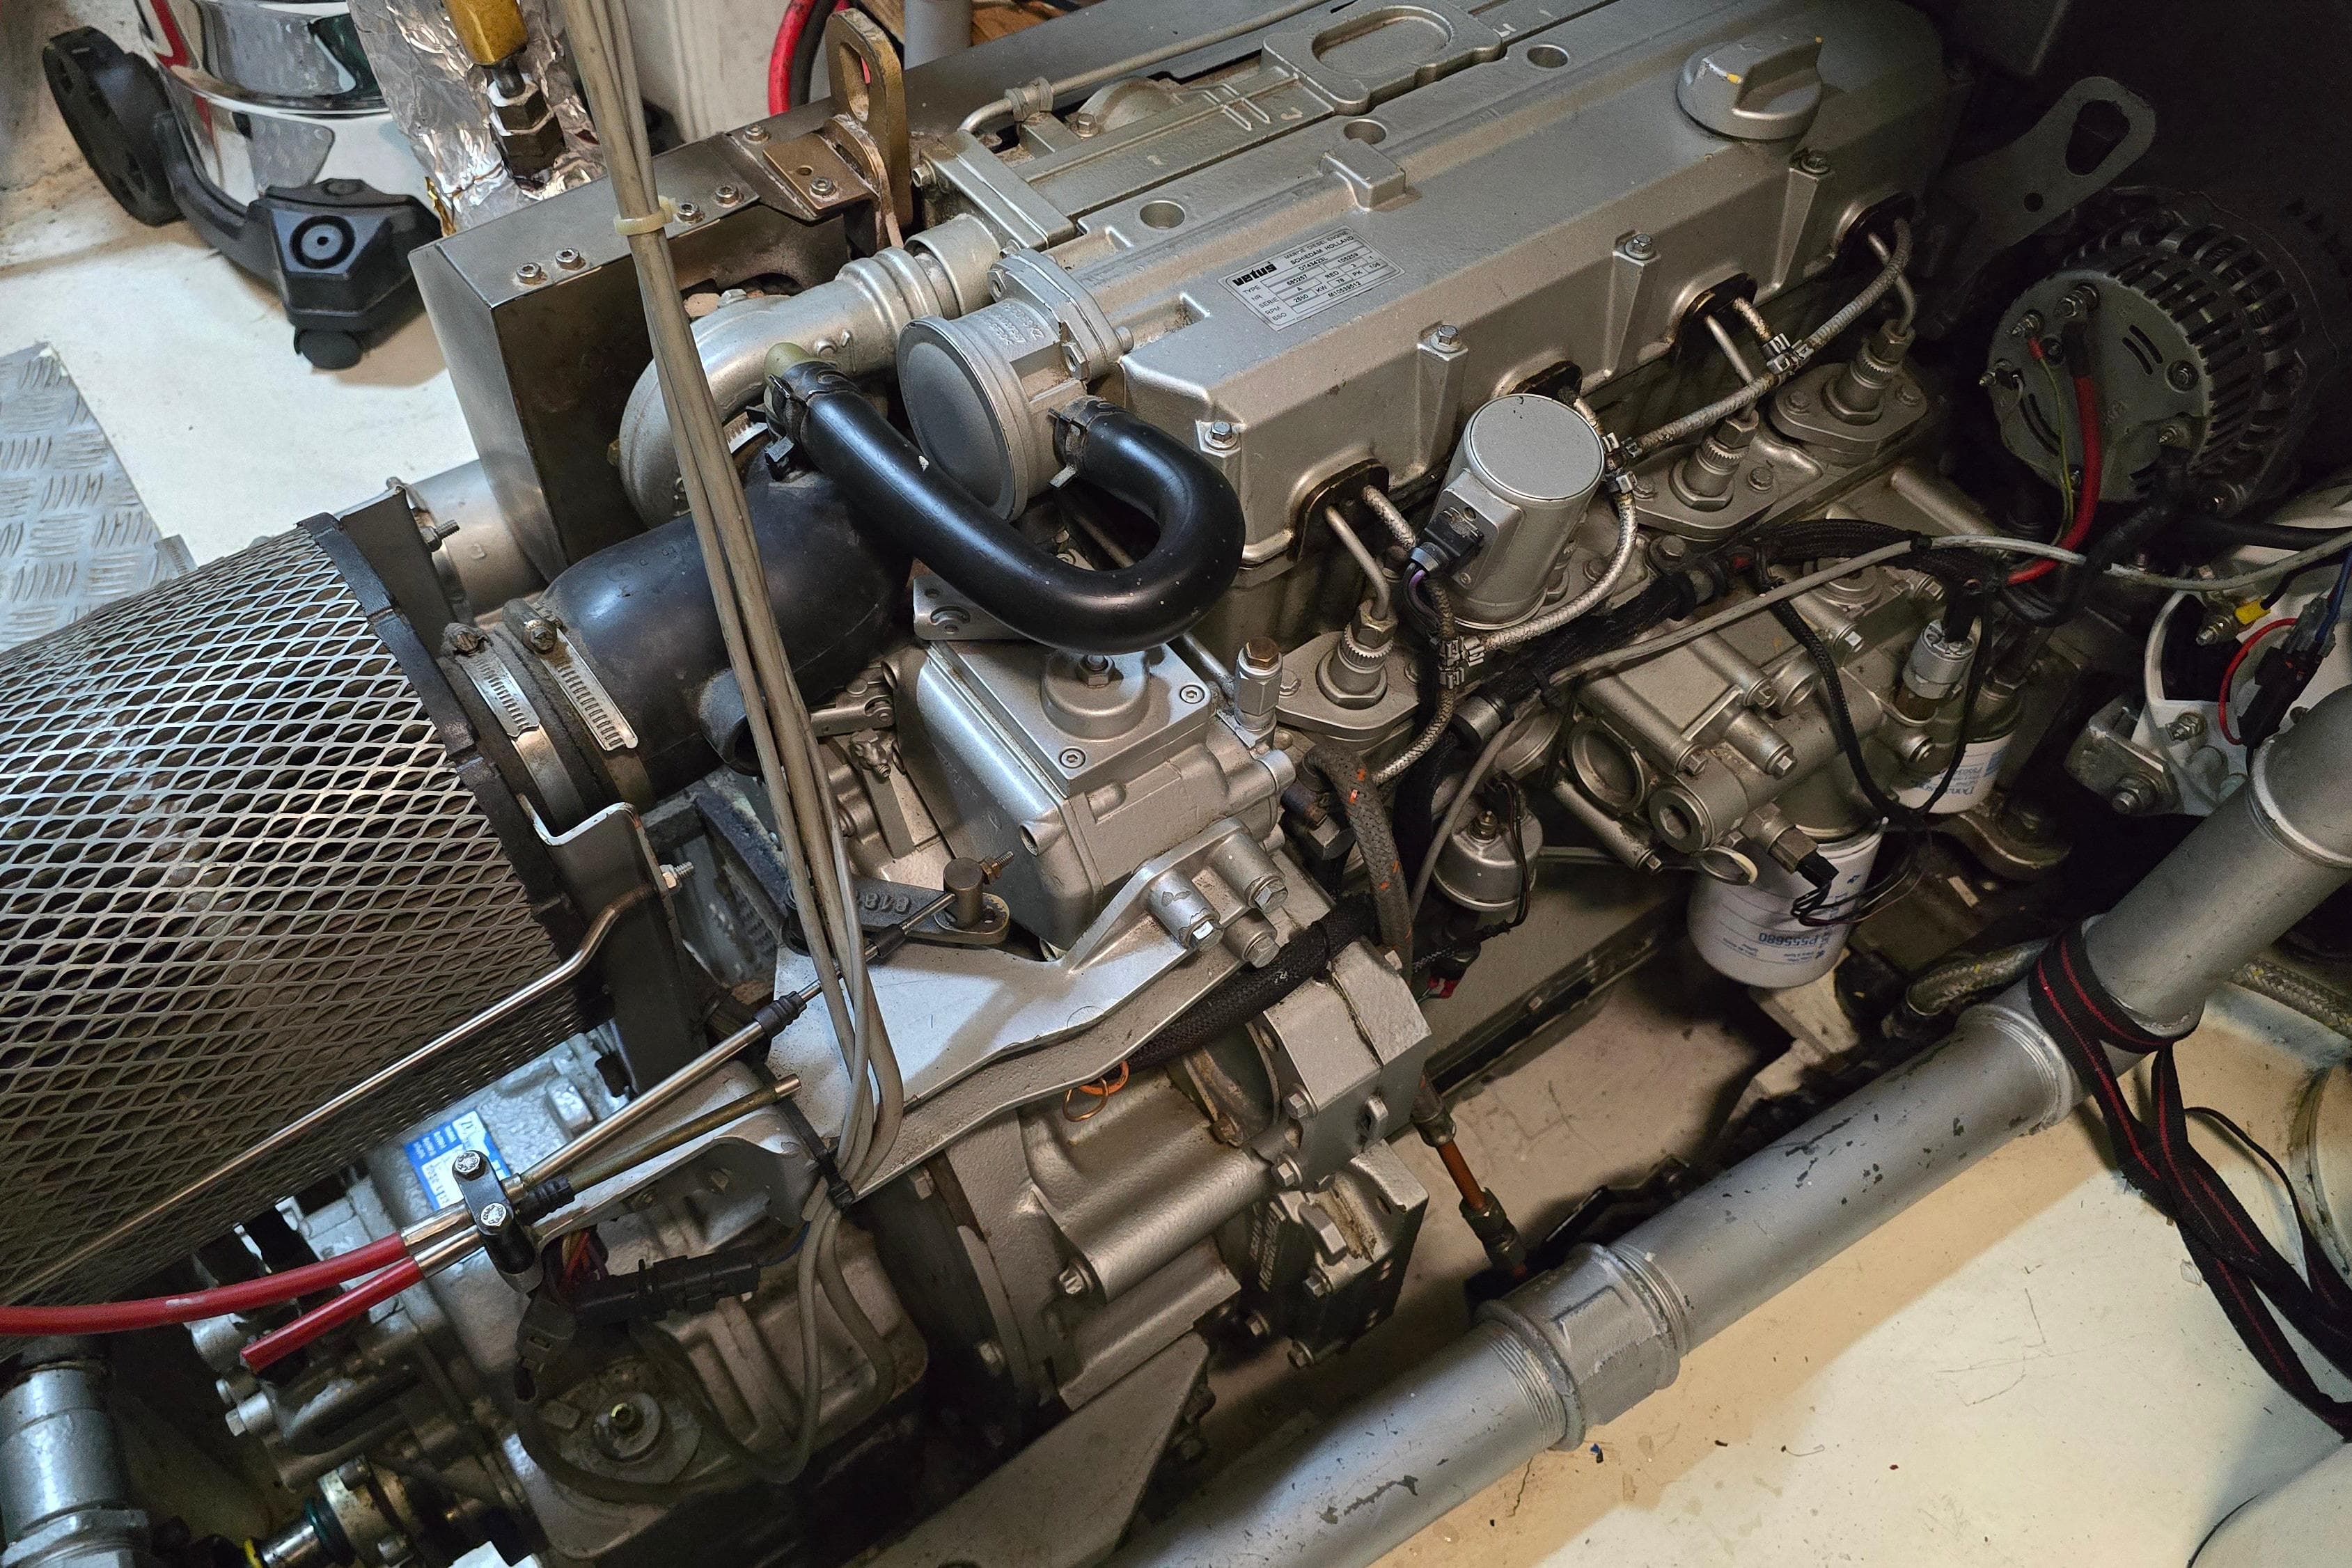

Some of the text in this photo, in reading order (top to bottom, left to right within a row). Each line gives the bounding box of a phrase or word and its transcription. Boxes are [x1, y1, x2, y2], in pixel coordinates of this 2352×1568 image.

[1290, 236, 1354, 265] SCHIEDAM HOLLAND
[1232, 263, 1277, 286] vetus
[1242, 285, 1261, 295] TYPE
[1258, 297, 1280, 308] SERIE
[1324, 271, 1340, 279] RED
[1264, 306, 1281, 315] RPM
[1759, 932, 1818, 946] P555680
